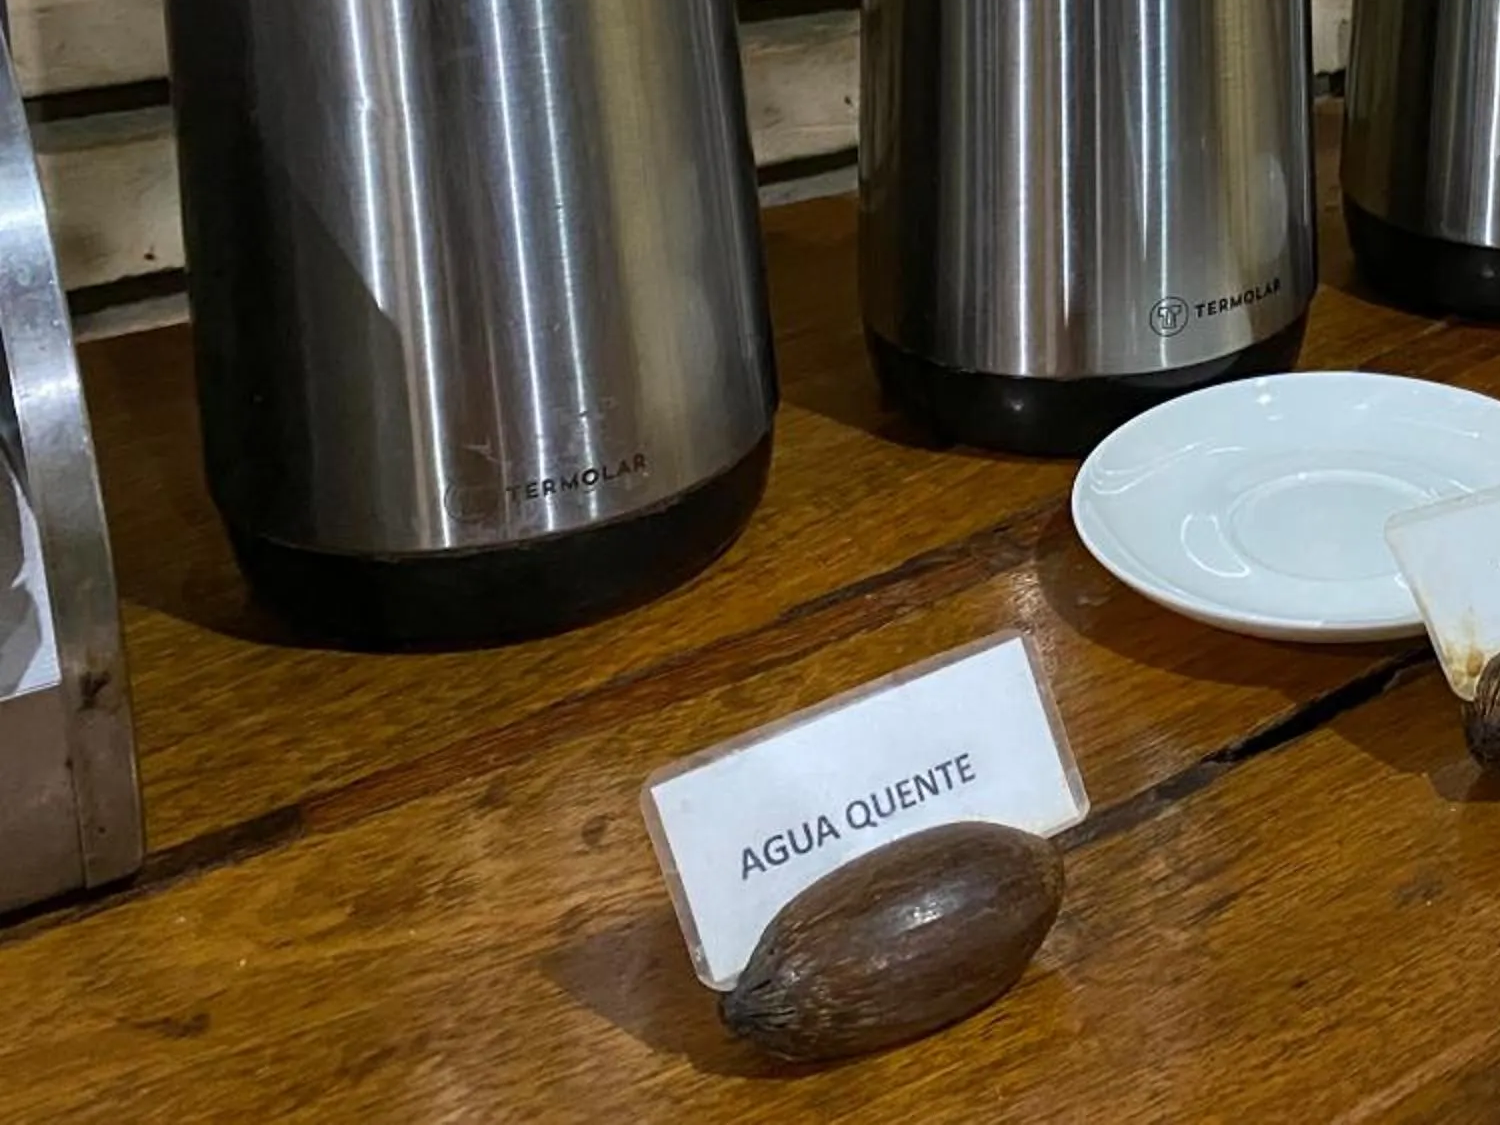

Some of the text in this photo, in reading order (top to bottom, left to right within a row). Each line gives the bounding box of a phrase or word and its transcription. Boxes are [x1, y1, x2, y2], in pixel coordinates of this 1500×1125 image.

[506, 453, 647, 502] TERMOLAR
[741, 752, 977, 880] AGUA QUENTE
